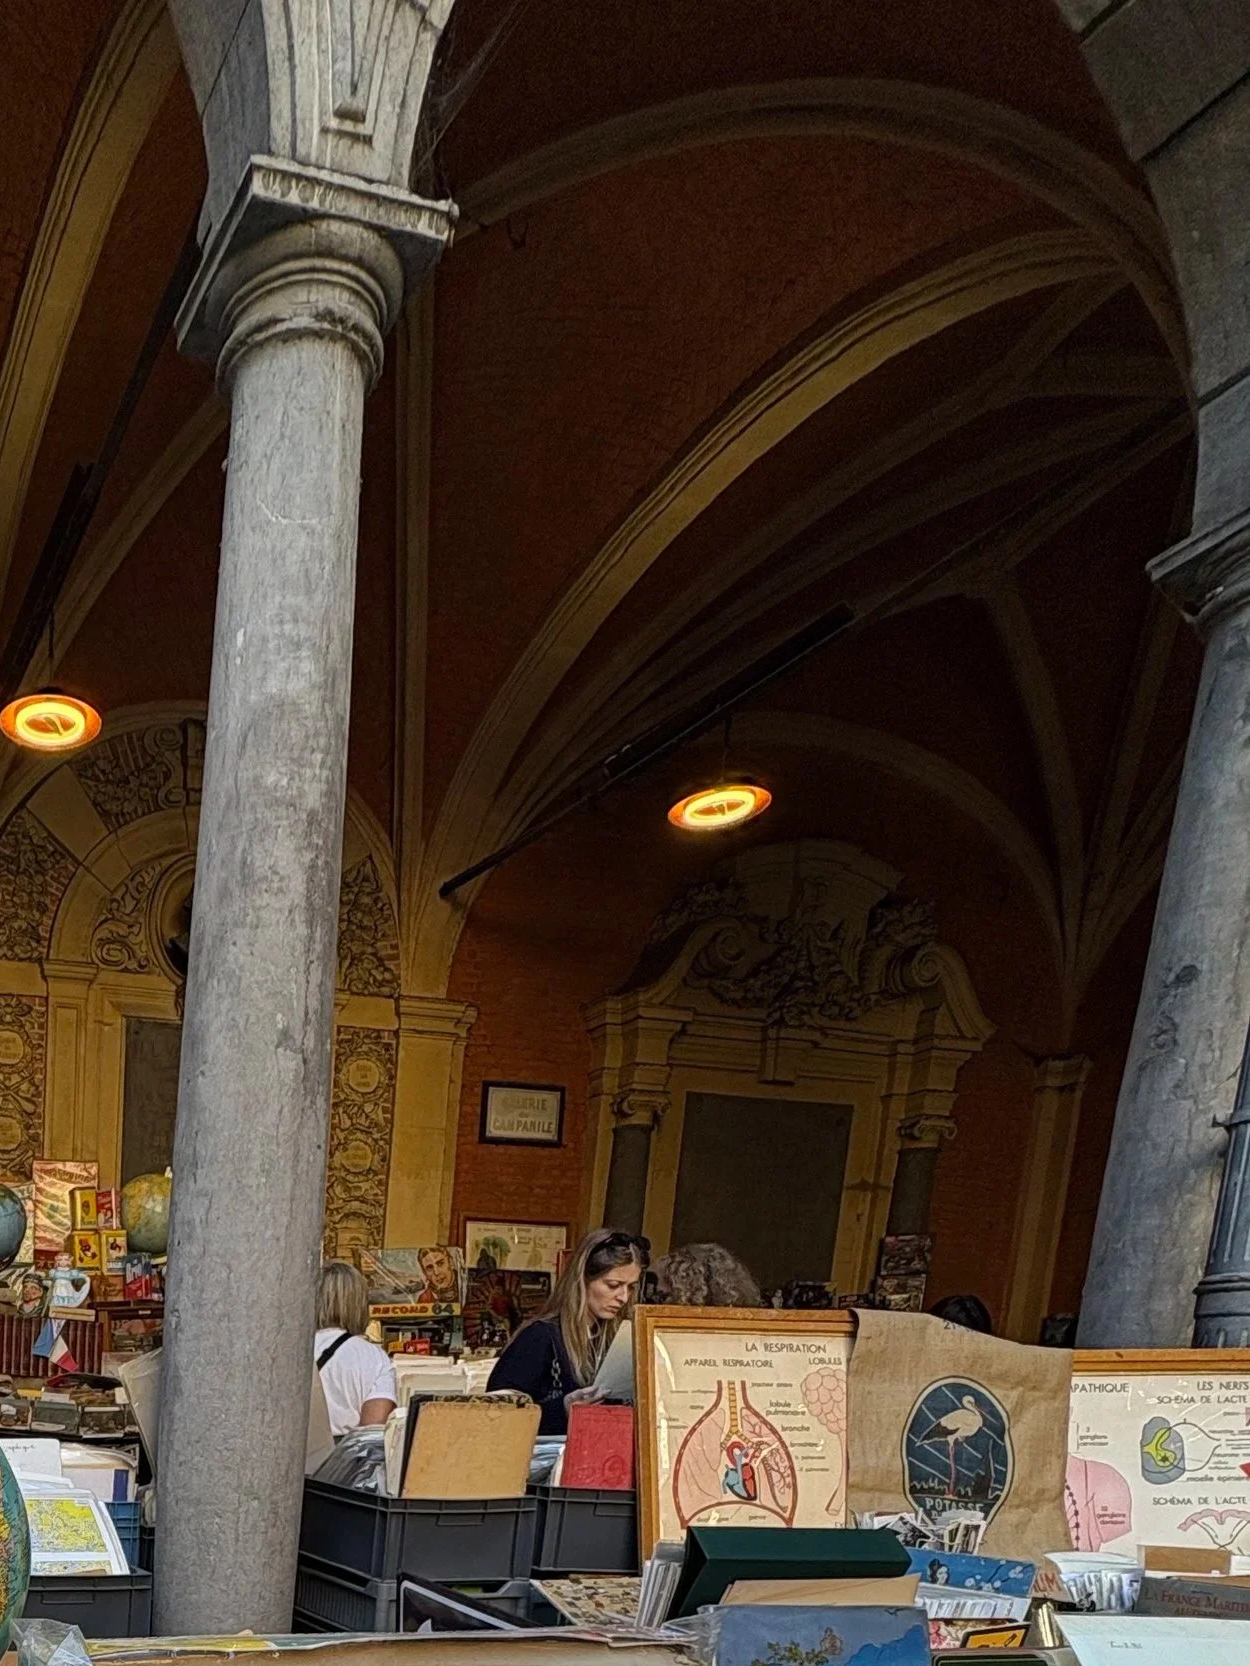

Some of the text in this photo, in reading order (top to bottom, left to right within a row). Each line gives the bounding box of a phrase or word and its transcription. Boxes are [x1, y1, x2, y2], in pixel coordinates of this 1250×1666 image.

[493, 1117, 554, 1134] CAMPANILE
[746, 1342, 827, 1354] LA RESPIRATION
[684, 1359, 774, 1369] APPAREIL RESPIRATOIRE
[808, 1357, 843, 1366] LOBULES
[1197, 1381, 1214, 1391] LES
[1200, 1395, 1212, 1404] DE
[925, 1498, 986, 1513] POTASSE
[1198, 1496, 1210, 1505] DE
